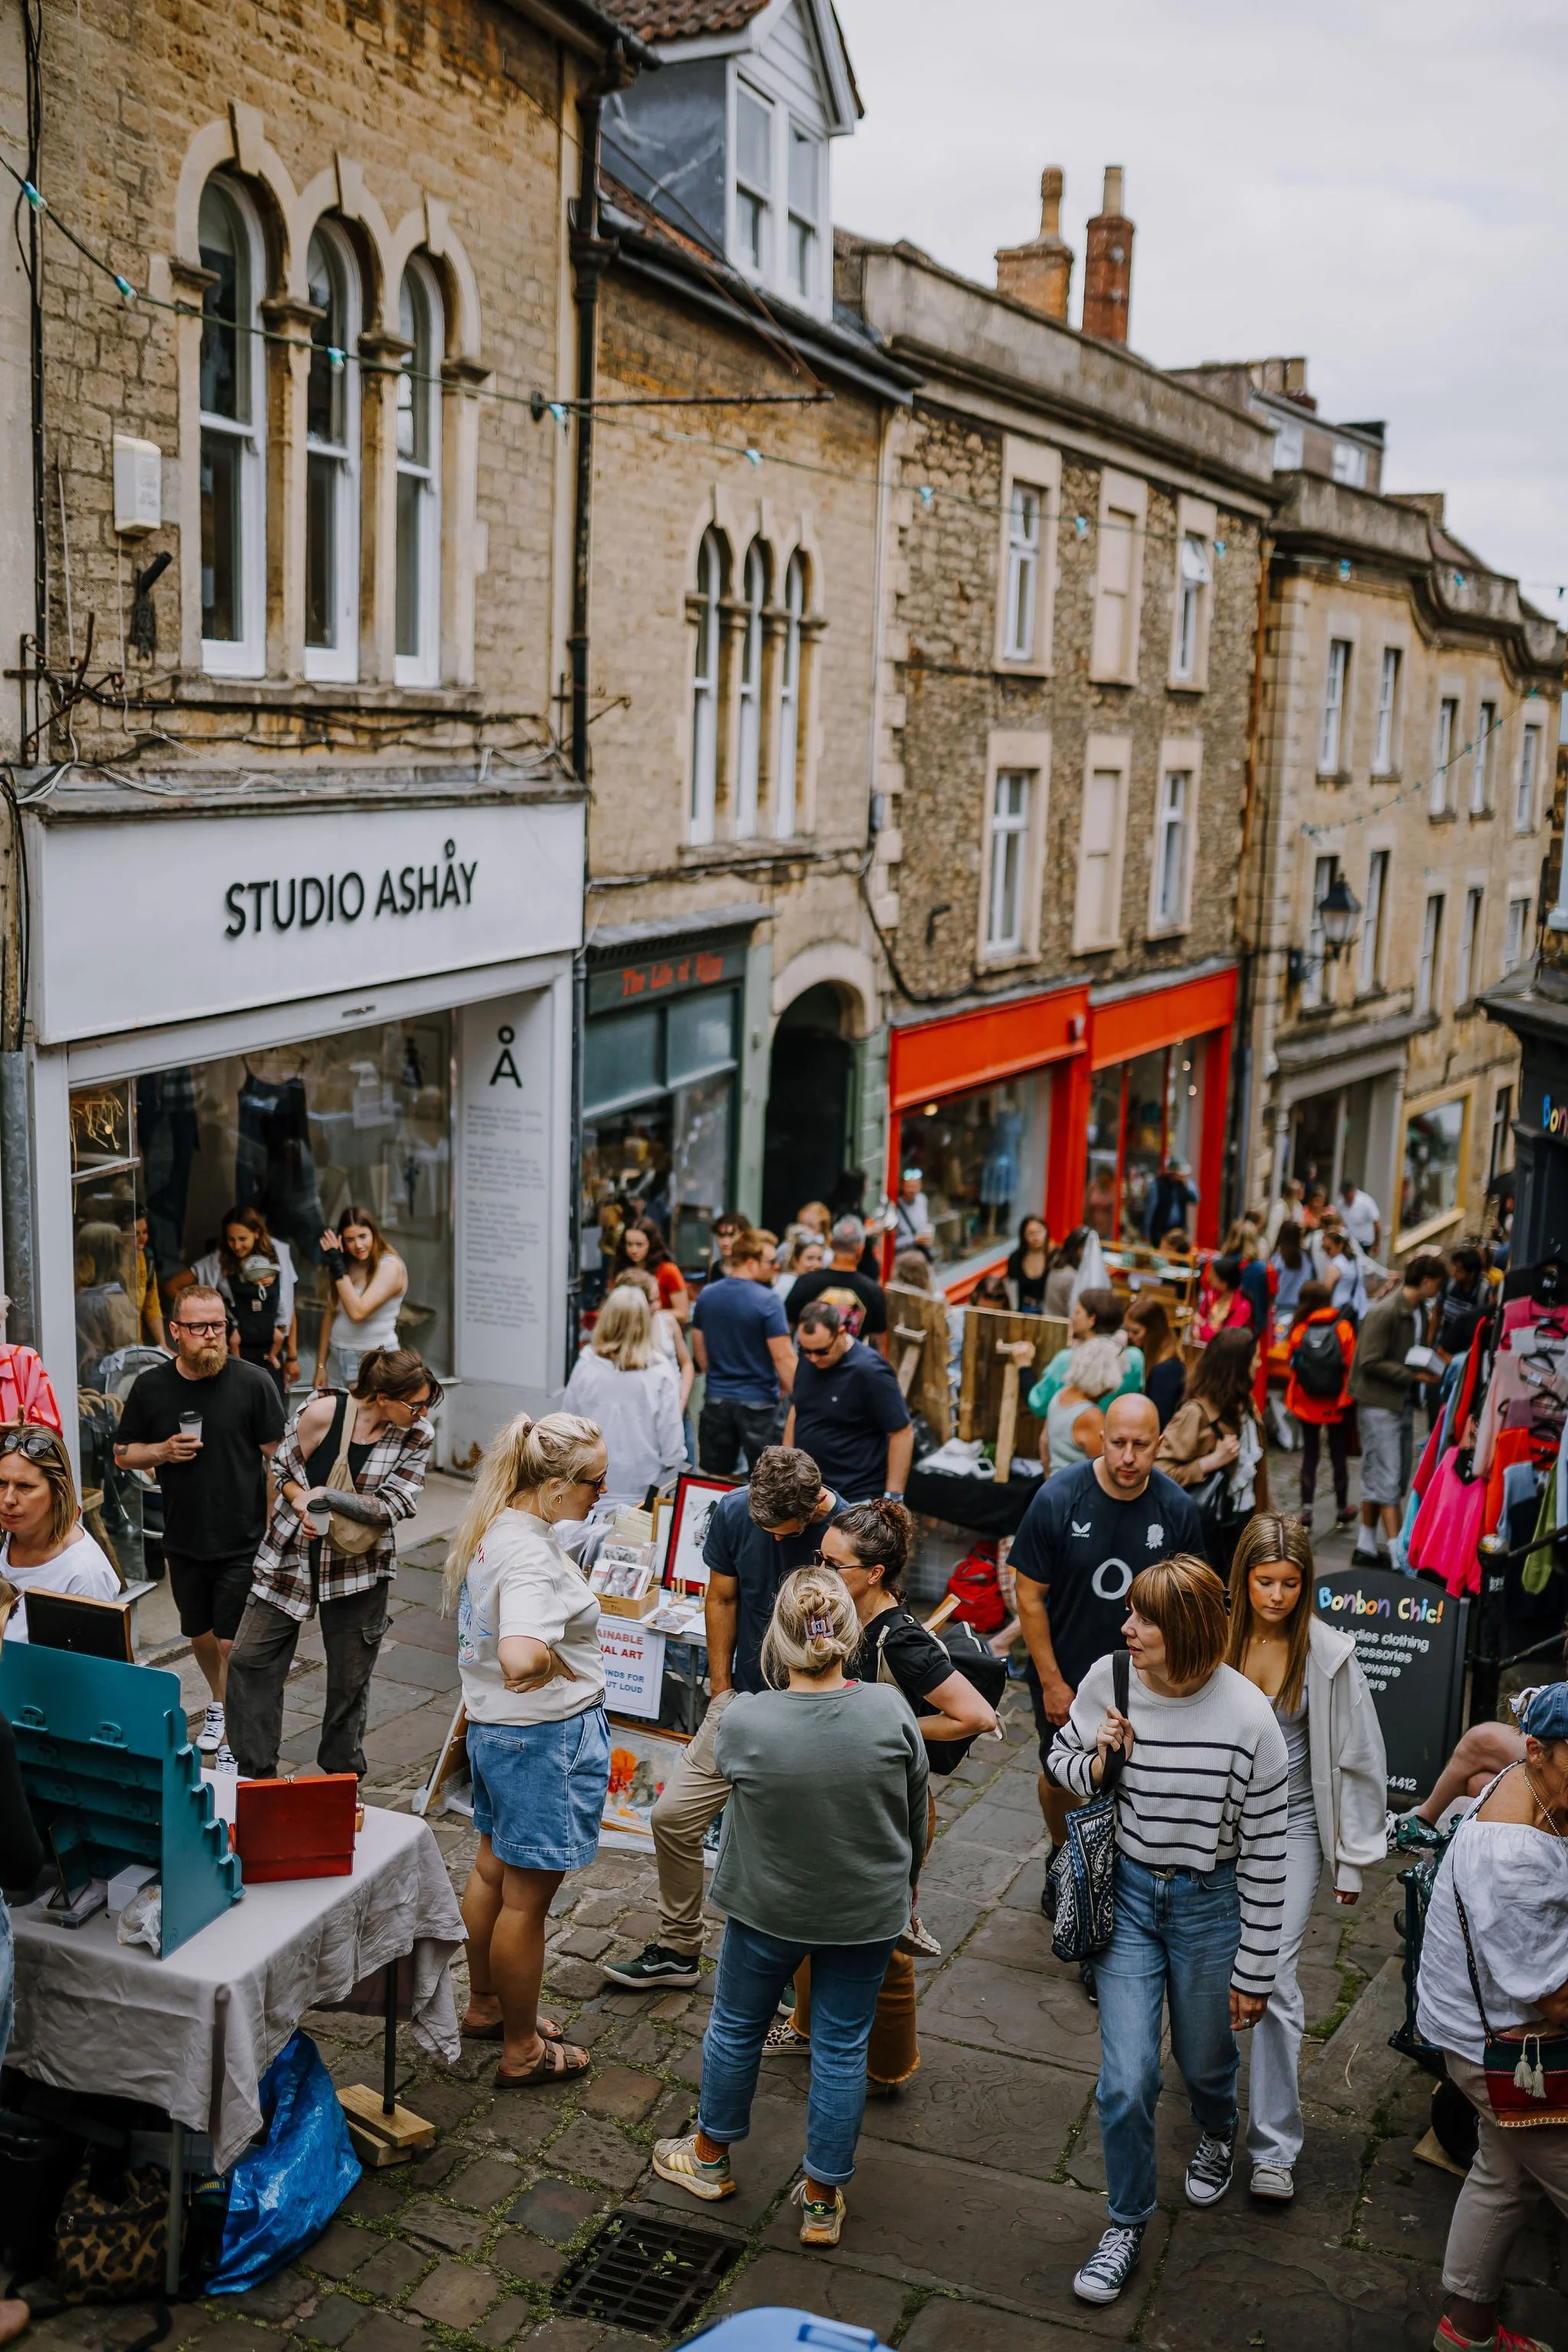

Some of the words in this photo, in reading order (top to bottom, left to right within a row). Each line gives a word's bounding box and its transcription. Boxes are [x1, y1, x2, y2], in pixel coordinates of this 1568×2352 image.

[225, 871, 364, 936] STUDIO
[1543, 1093, 1568, 1139] Bon
[1318, 1586, 1391, 1619] Bonbon
[1398, 1597, 1445, 1624] Chic!
[596, 1628, 643, 1645] AINABLE
[1381, 1633, 1429, 1653] clothing
[621, 1648, 644, 1661] ART
[1354, 1645, 1413, 1664] cessories
[627, 1673, 645, 1683] FOR
[619, 1683, 643, 1694] LOUD
